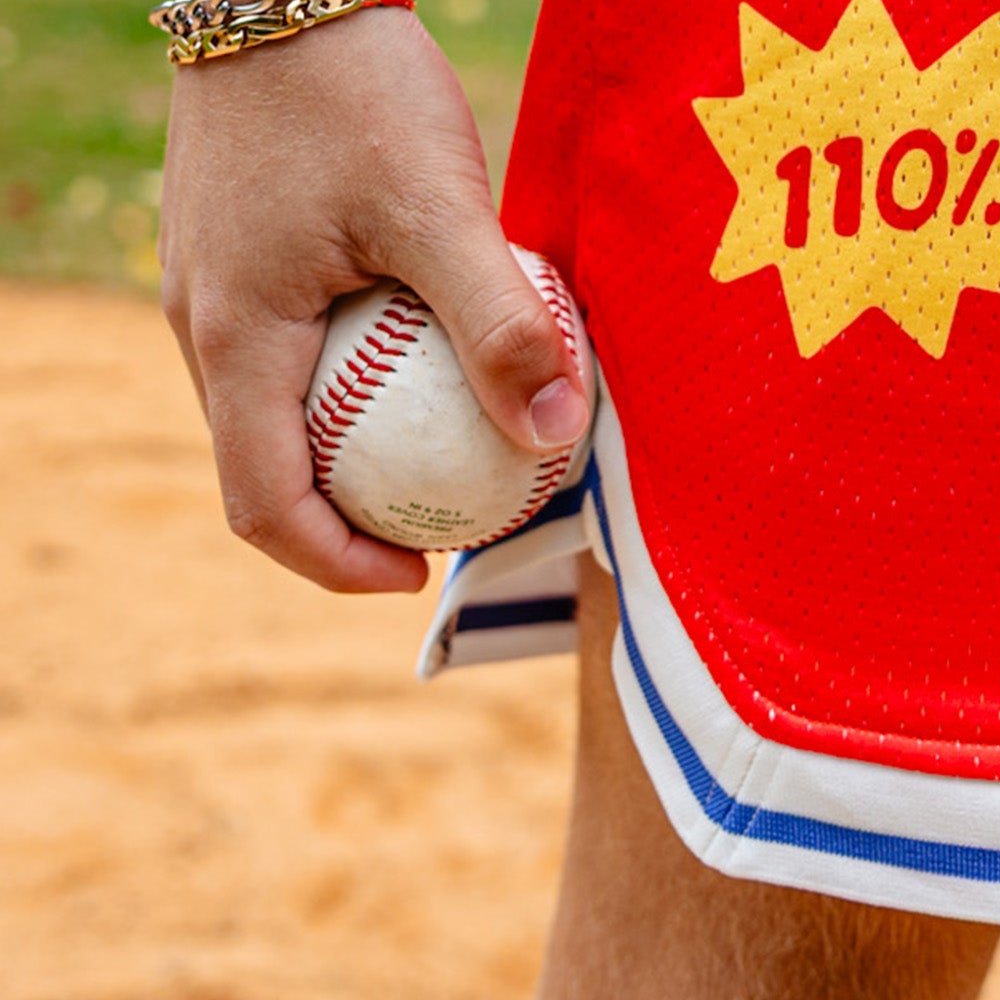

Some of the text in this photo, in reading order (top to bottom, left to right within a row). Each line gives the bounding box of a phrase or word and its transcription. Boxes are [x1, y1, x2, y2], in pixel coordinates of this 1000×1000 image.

[409, 502, 422, 510] IN
[388, 505, 424, 519] COVER
[434, 508, 451, 516] OZ
[401, 518, 453, 532] PREMIUM
[428, 517, 474, 525] LEATHER
